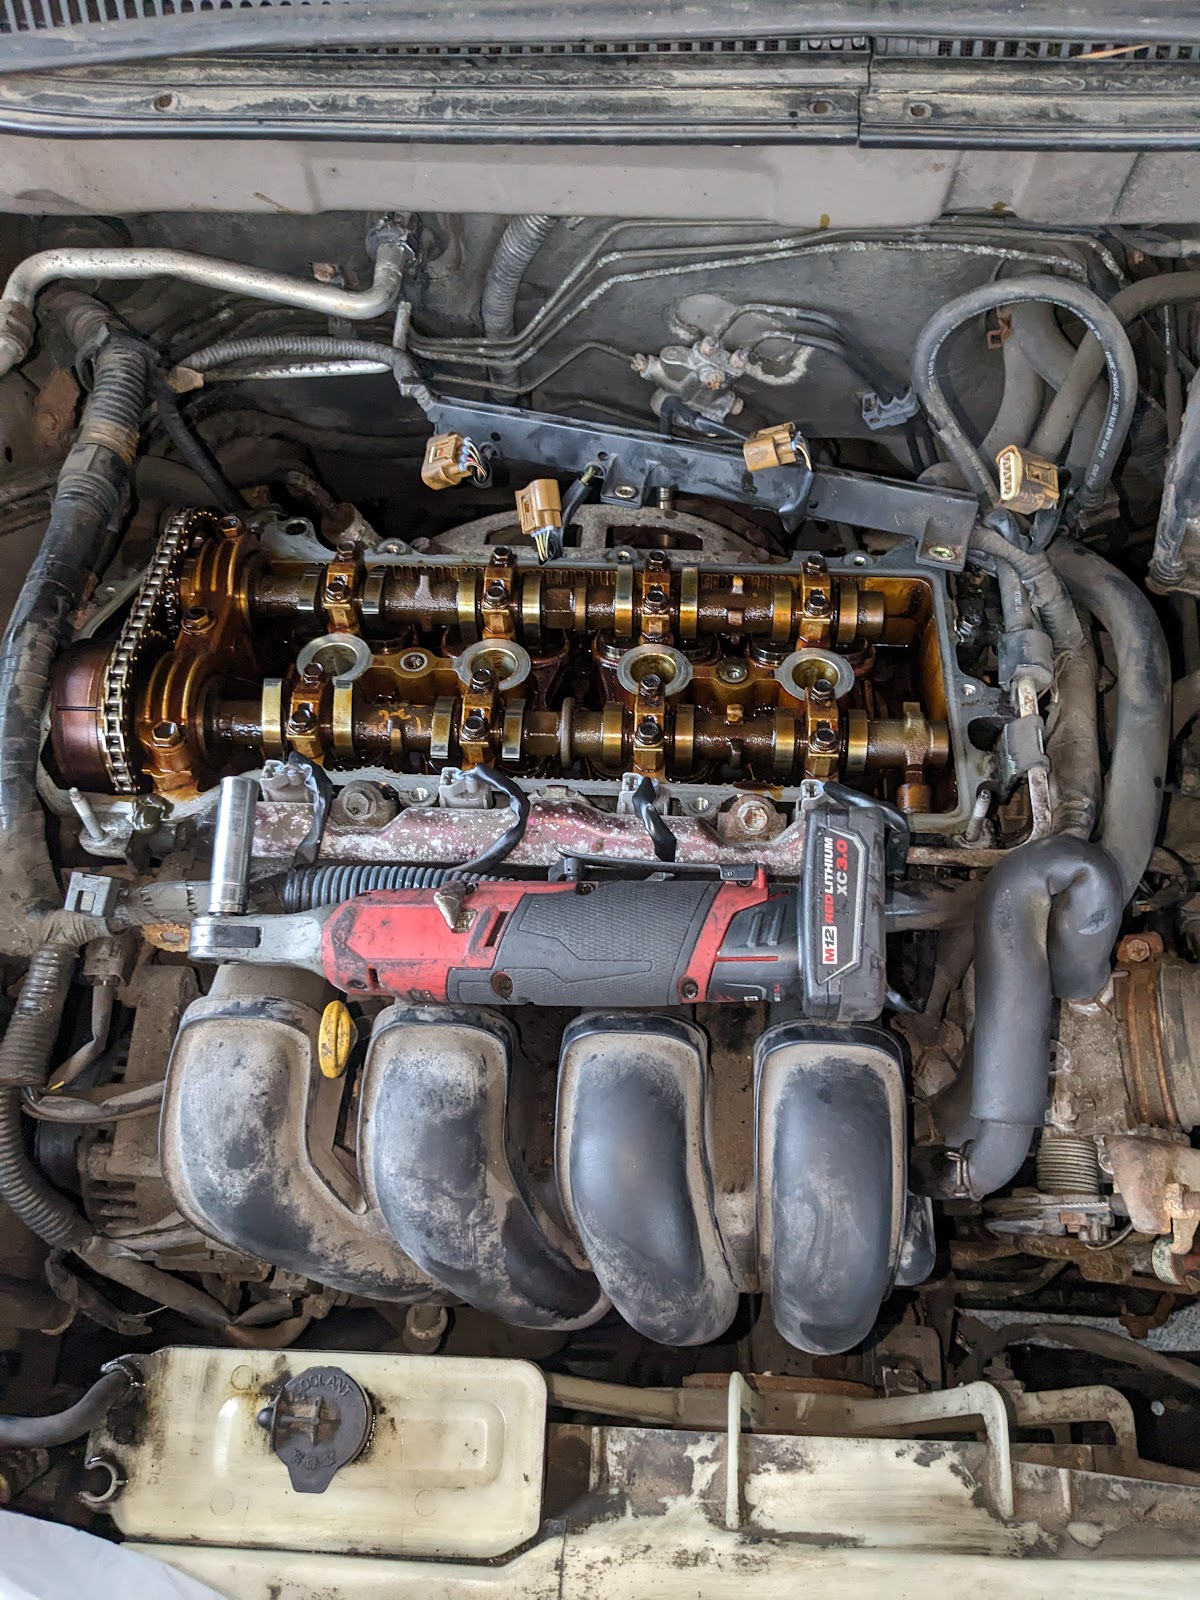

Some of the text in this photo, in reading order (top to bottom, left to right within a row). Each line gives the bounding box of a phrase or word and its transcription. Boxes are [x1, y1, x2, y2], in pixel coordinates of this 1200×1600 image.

[1098, 450, 1105, 459] DO
[1101, 440, 1109, 450] NOT
[836, 840, 848, 896] XC3.0
[823, 837, 836, 963] M12 REDLITHIUM
[292, 1374, 354, 1397] COOLANT
